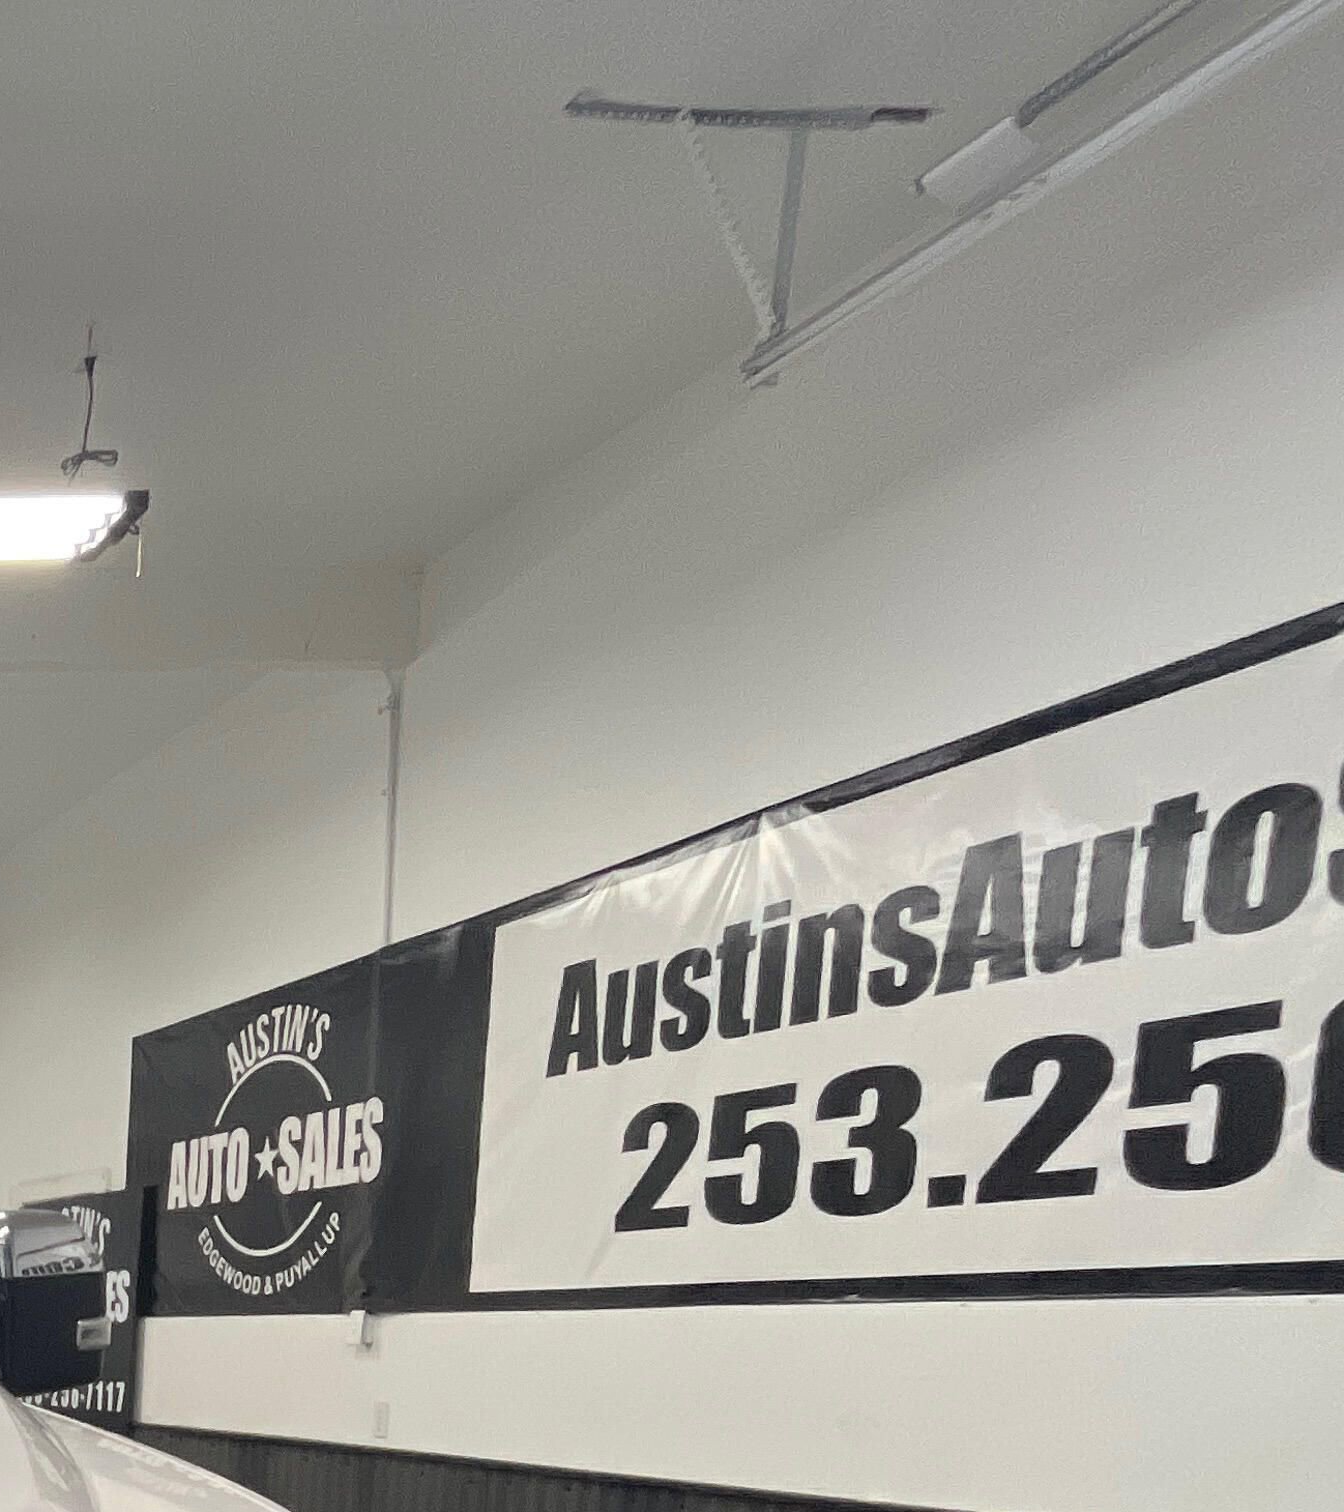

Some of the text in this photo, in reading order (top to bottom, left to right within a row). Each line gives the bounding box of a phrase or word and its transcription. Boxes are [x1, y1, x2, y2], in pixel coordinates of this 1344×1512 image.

[546, 758, 1344, 1078] AustinsAuto
[227, 1004, 330, 1084] AUSTIN'S
[167, 1097, 384, 1210] AUTO SALES
[614, 1000, 1344, 1233] 253.25
[198, 1212, 340, 1295] EDGEWOOD & PUYALLUP
